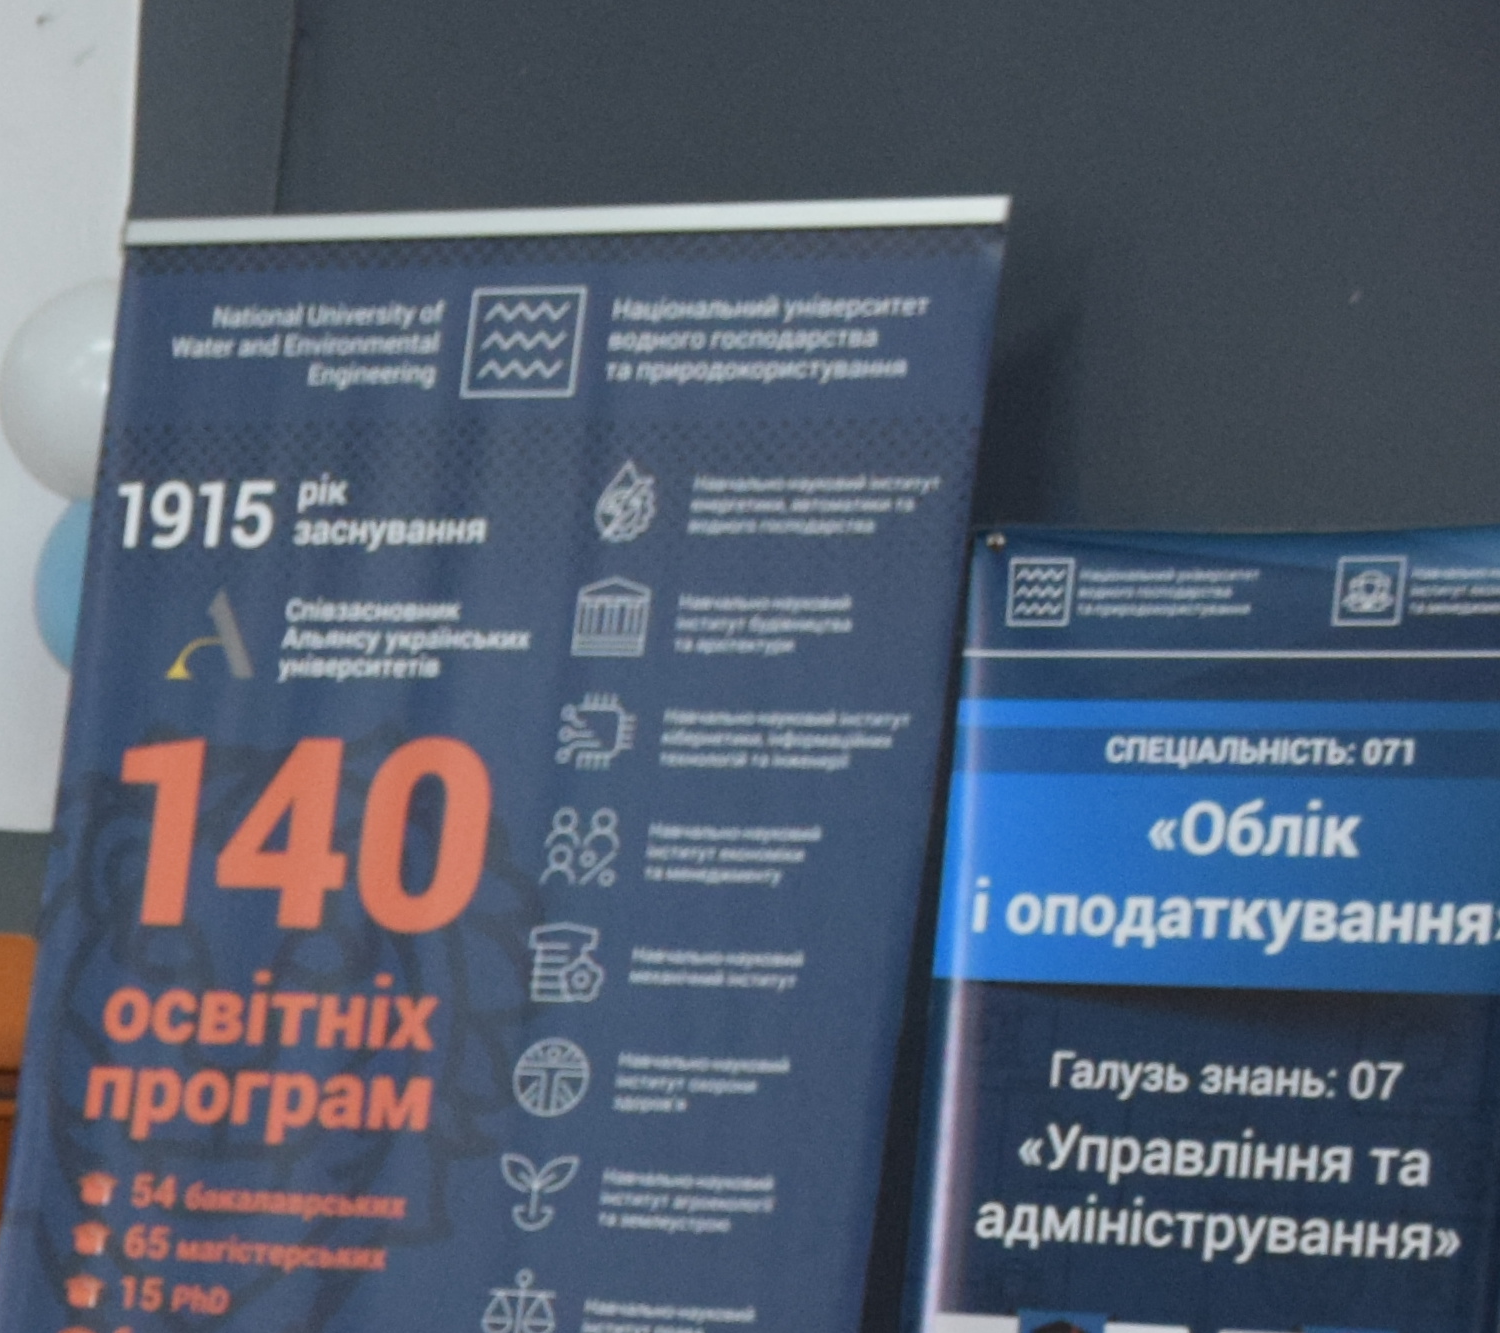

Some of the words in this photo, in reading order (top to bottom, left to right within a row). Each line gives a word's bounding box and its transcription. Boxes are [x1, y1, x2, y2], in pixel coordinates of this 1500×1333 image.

[306, 301, 415, 329] University
[419, 298, 446, 324] of
[172, 335, 235, 359] Water
[237, 333, 280, 357] and
[282, 331, 442, 357] Environmental
[306, 361, 438, 390] Engineering
[117, 478, 277, 550] 1915
[296, 472, 349, 514] рік
[292, 517, 488, 553] заснування
[1104, 734, 1357, 770] СПЕЦІАЛЬНІСТЬ:
[1360, 736, 1417, 768] 071
[120, 735, 493, 933] 140
[1146, 797, 1364, 859] «Облік
[972, 876, 993, 934] і
[1004, 892, 1500, 957] оподаткування
[103, 968, 441, 1052] освітніх
[1047, 1049, 1192, 1101] Галузь
[1198, 1061, 1338, 1100] знань:
[1346, 1060, 1405, 1101] 07
[83, 1063, 435, 1146] програм
[1018, 1121, 1355, 1186] «Управління
[1368, 1147, 1433, 1189] та
[129, 1172, 179, 1210] 54
[122, 1222, 173, 1261] 65
[974, 1193, 1463, 1266] адміністрування»
[119, 1274, 165, 1312] 15
[169, 1283, 233, 1316] PhD
